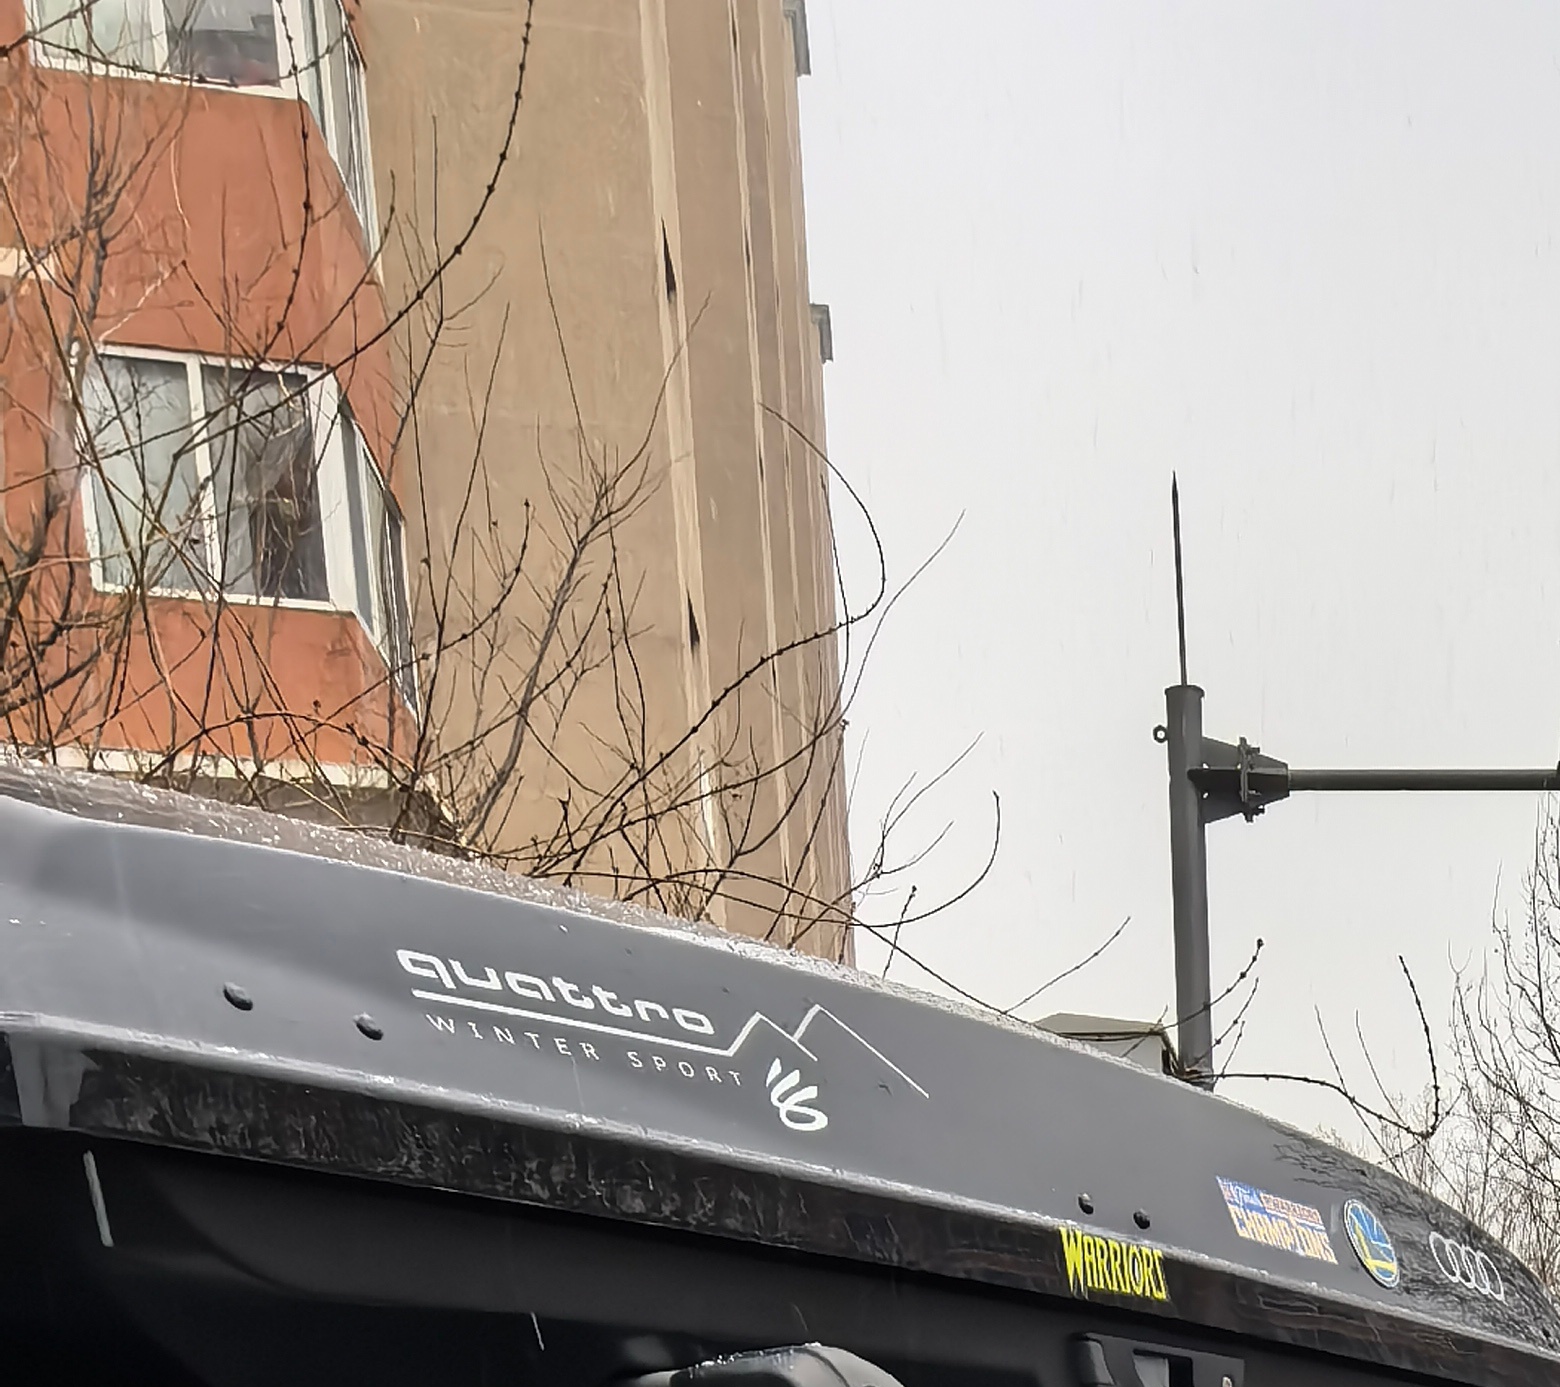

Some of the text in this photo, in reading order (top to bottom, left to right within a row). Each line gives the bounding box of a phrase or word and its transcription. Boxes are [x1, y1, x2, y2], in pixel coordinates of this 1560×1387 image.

[396, 949, 716, 1036] quattro
[425, 1013, 743, 1087] WINTER SPORT
[1059, 1226, 1168, 1301] WARRIORS
